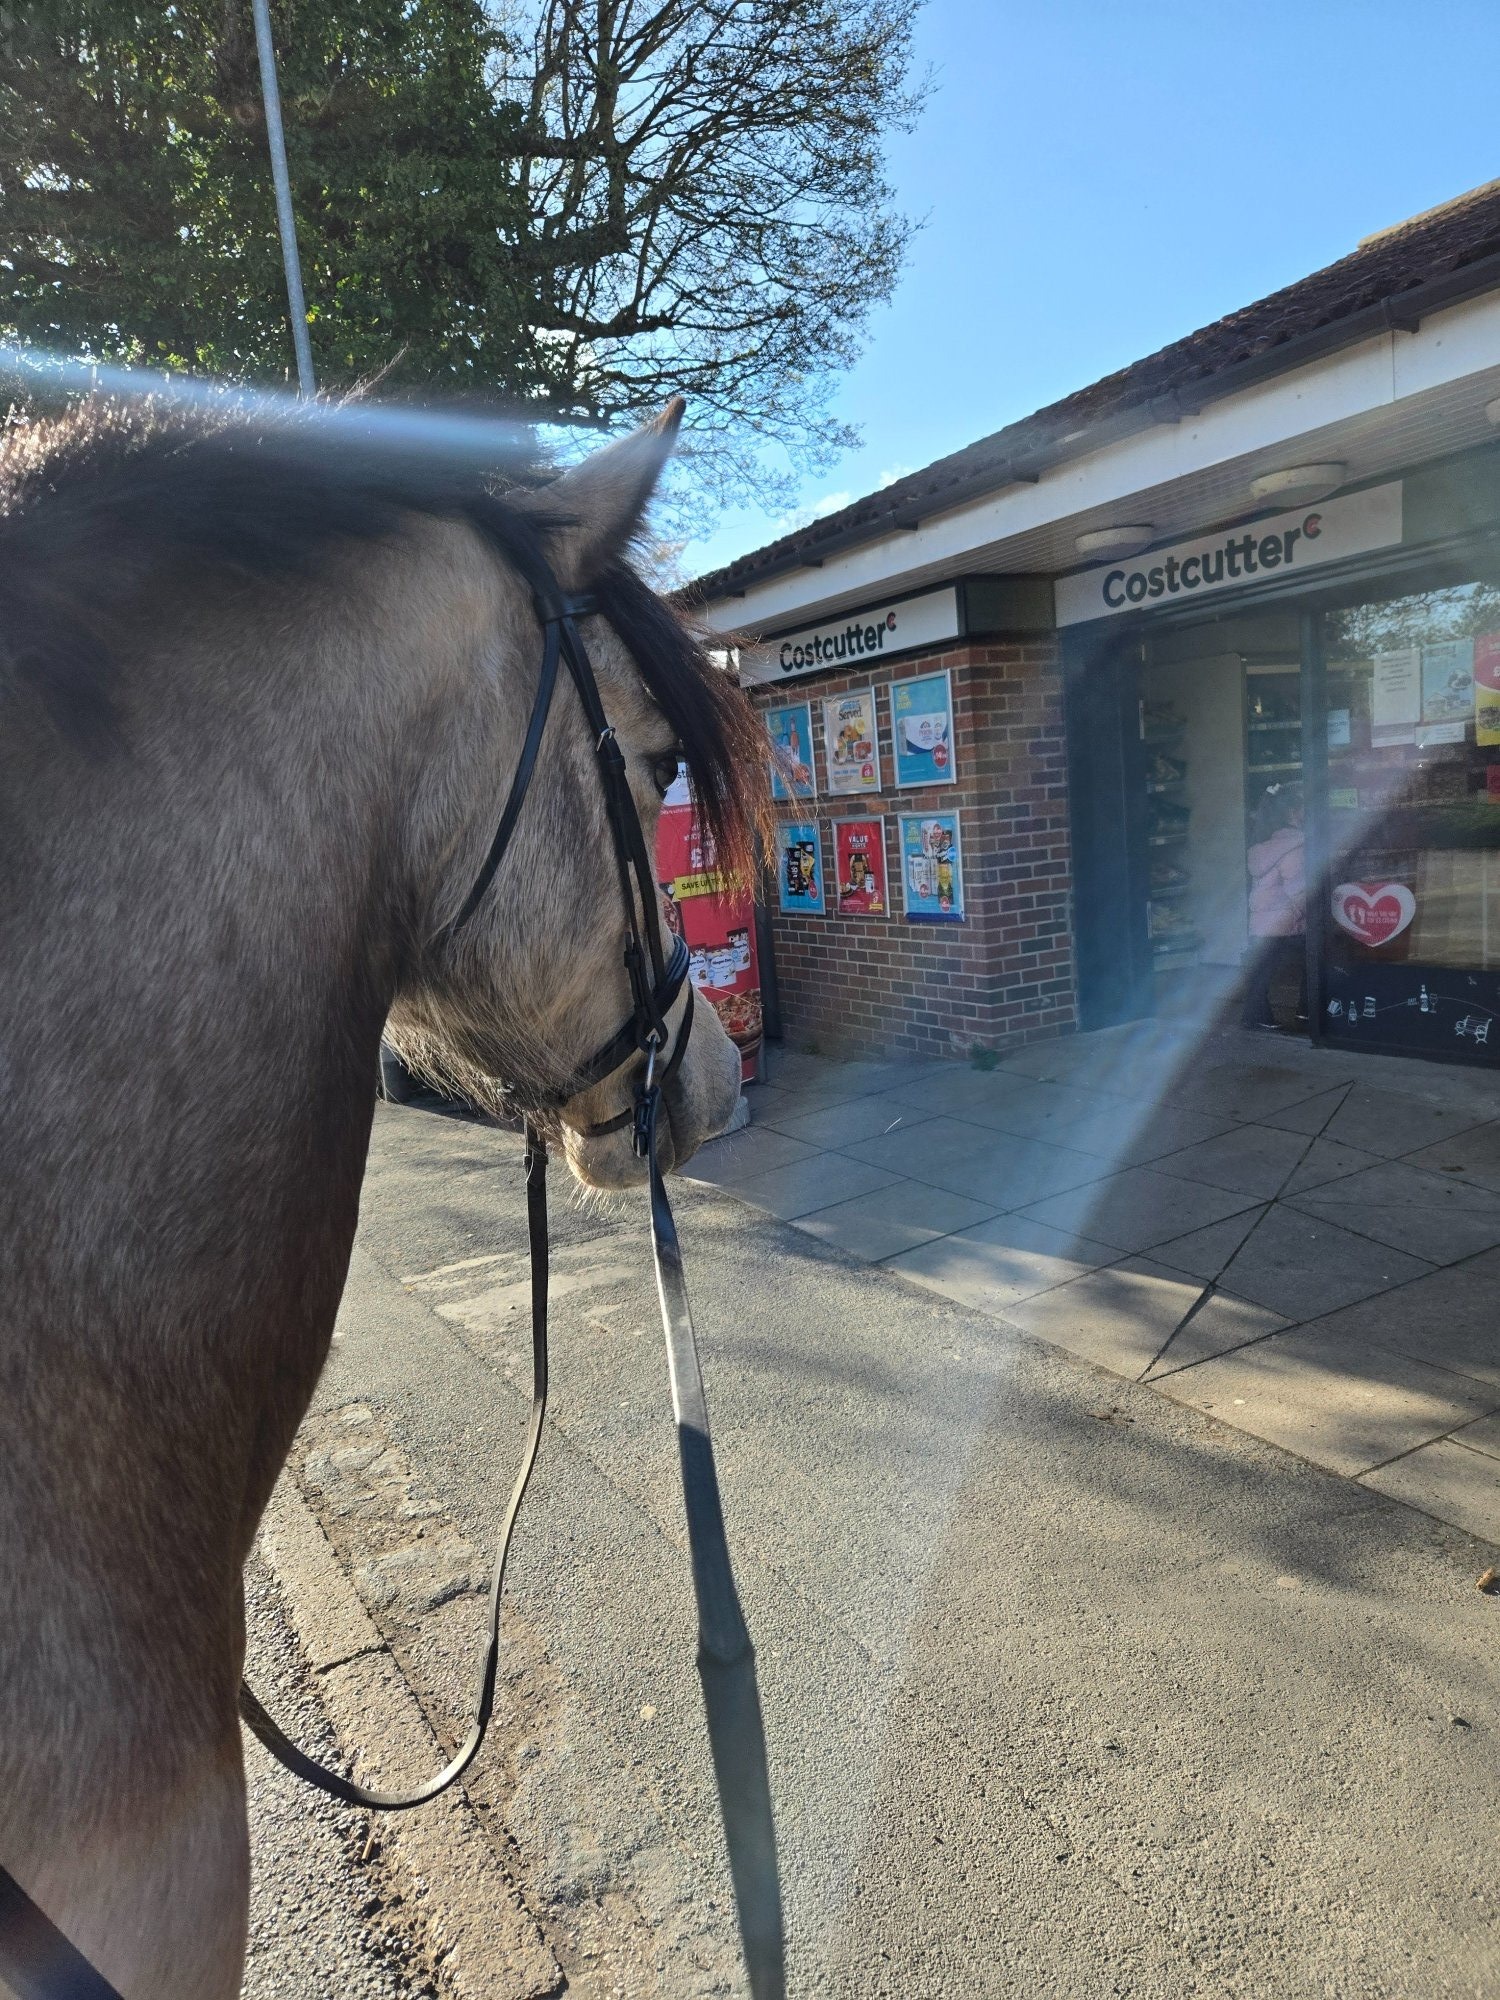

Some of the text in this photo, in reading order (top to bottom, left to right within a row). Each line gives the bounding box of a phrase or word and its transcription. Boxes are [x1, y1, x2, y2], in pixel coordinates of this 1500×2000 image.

[1102, 527, 1301, 608] Costcutter
[779, 623, 886, 673] Costcutter
[848, 834, 869, 844] VALUE
[681, 881, 700, 891] SAVE
